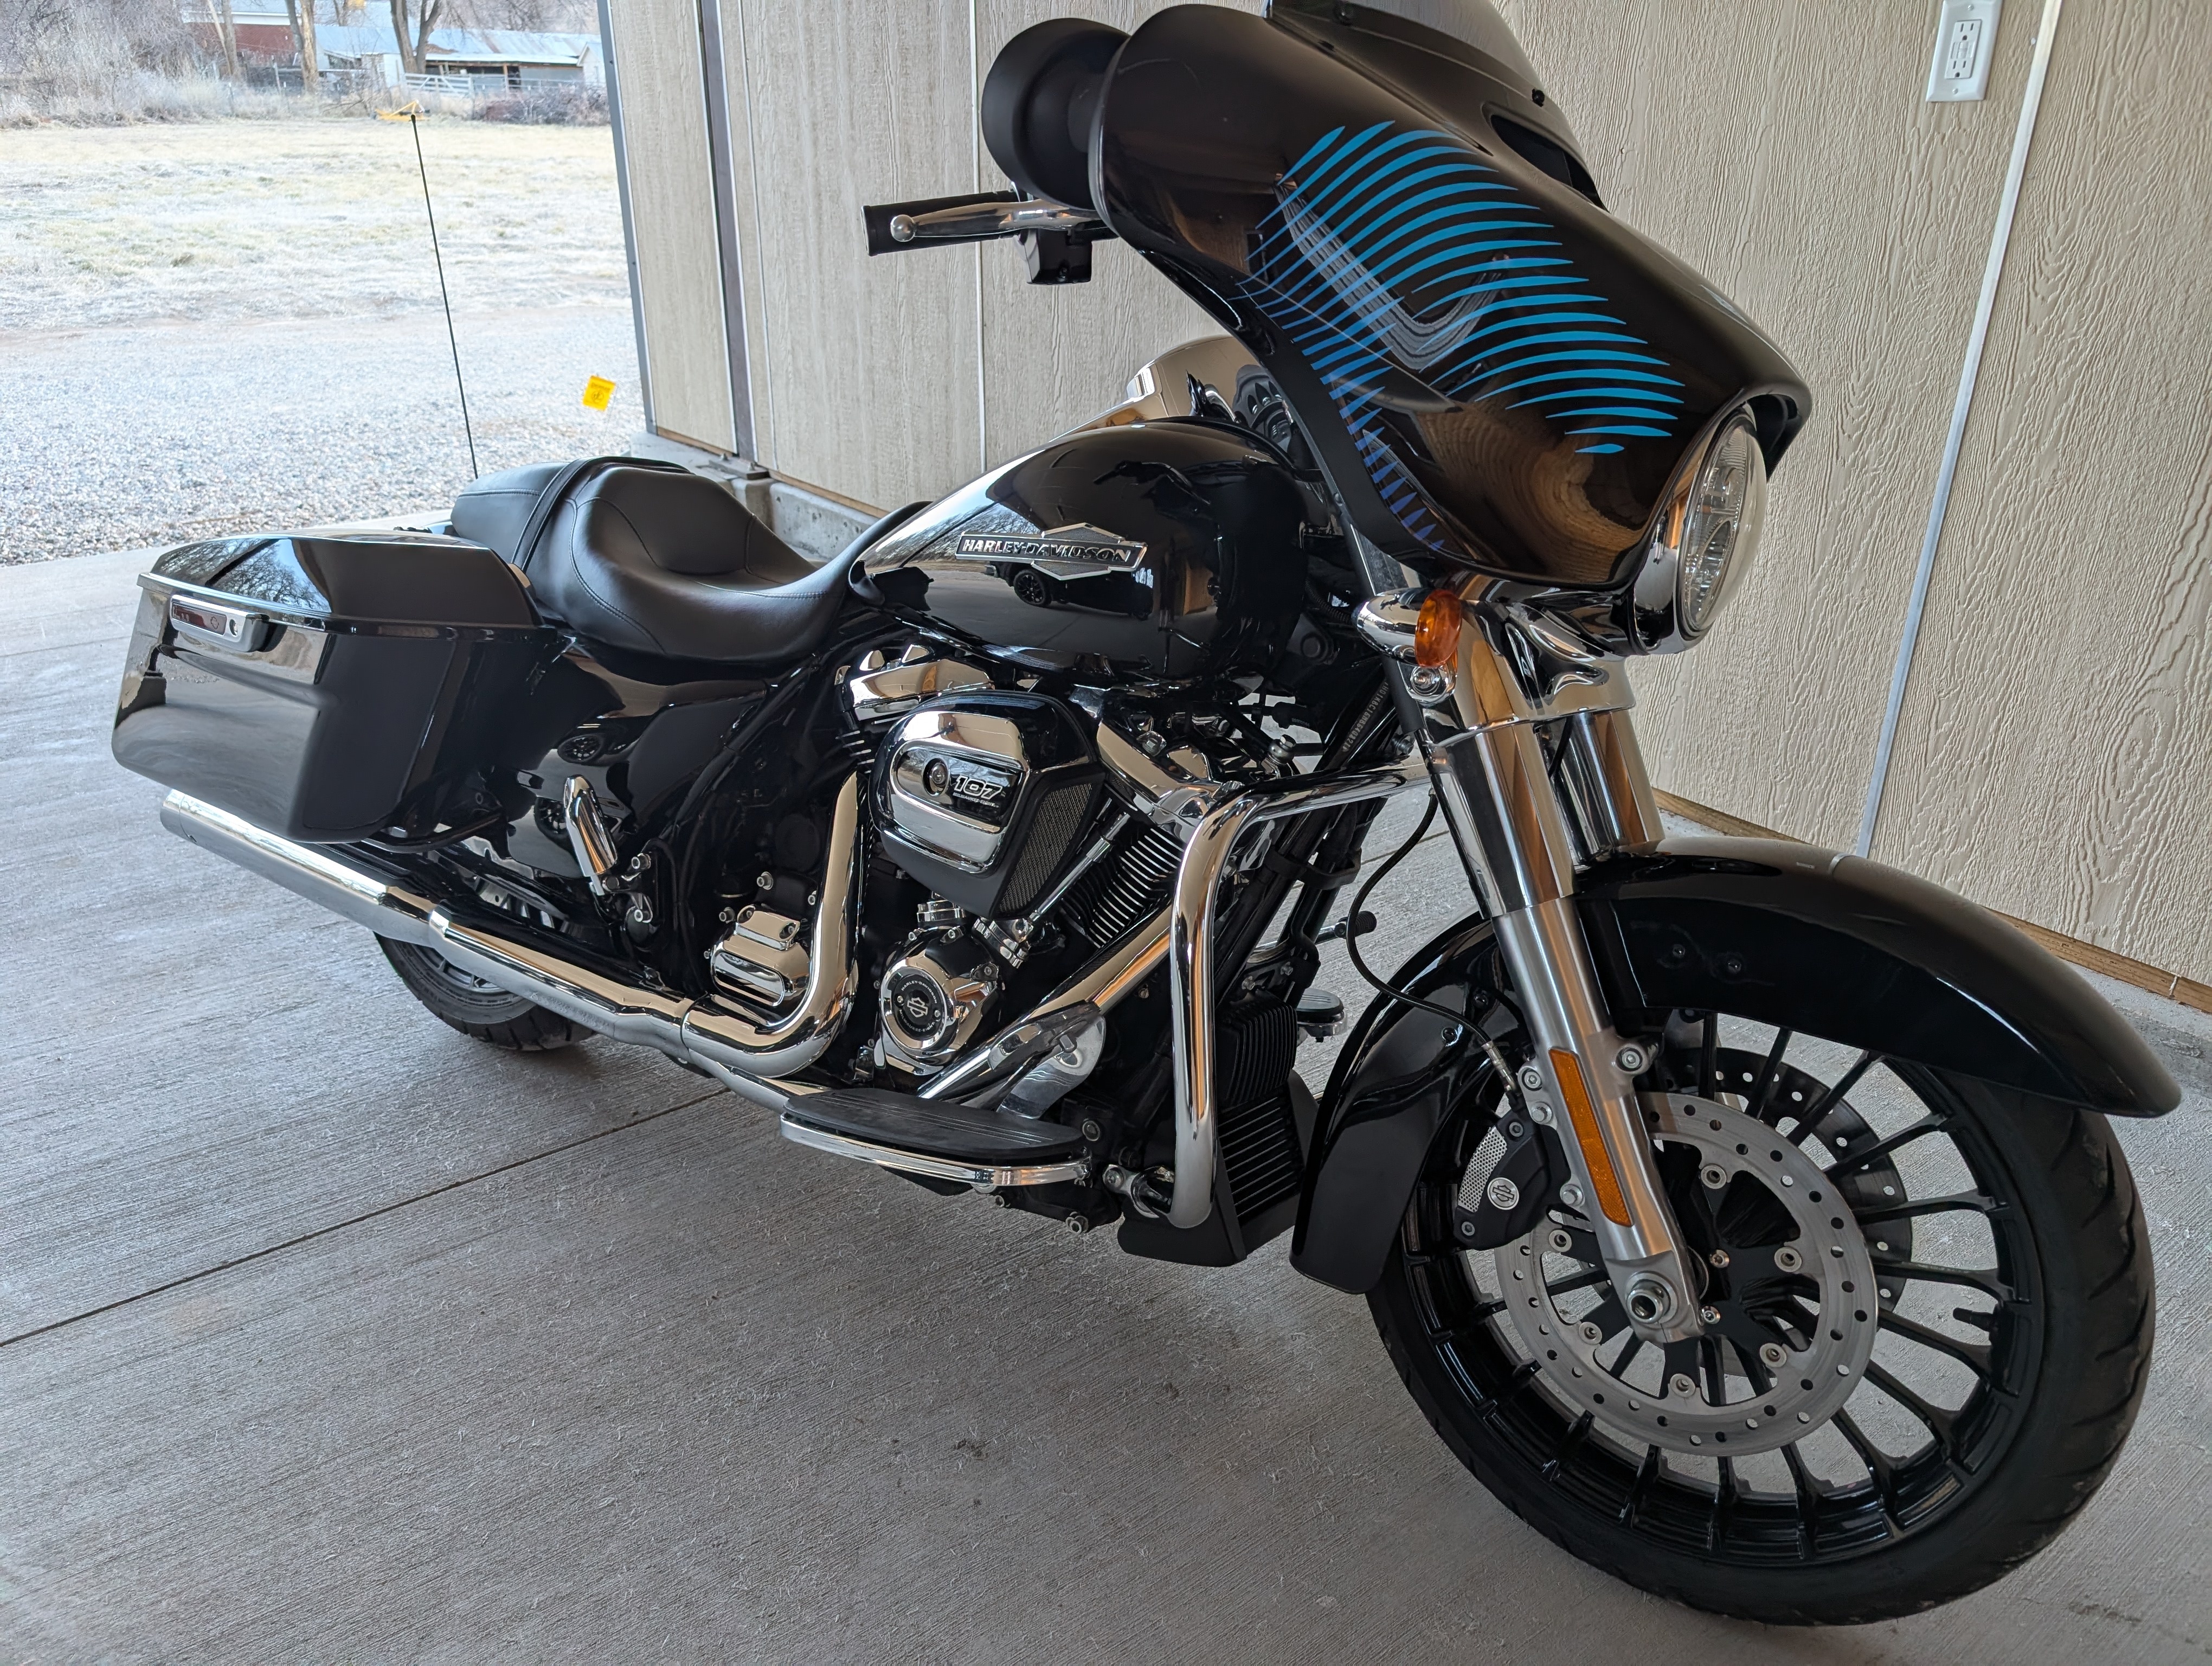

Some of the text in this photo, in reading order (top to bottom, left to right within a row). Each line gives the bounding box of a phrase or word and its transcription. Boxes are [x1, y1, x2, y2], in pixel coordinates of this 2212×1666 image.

[963, 539, 1131, 562] HARLEY-DAVIDSON
[954, 775, 1003, 799] 107
[901, 981, 937, 1004] HARLEY-DAVIDSON
